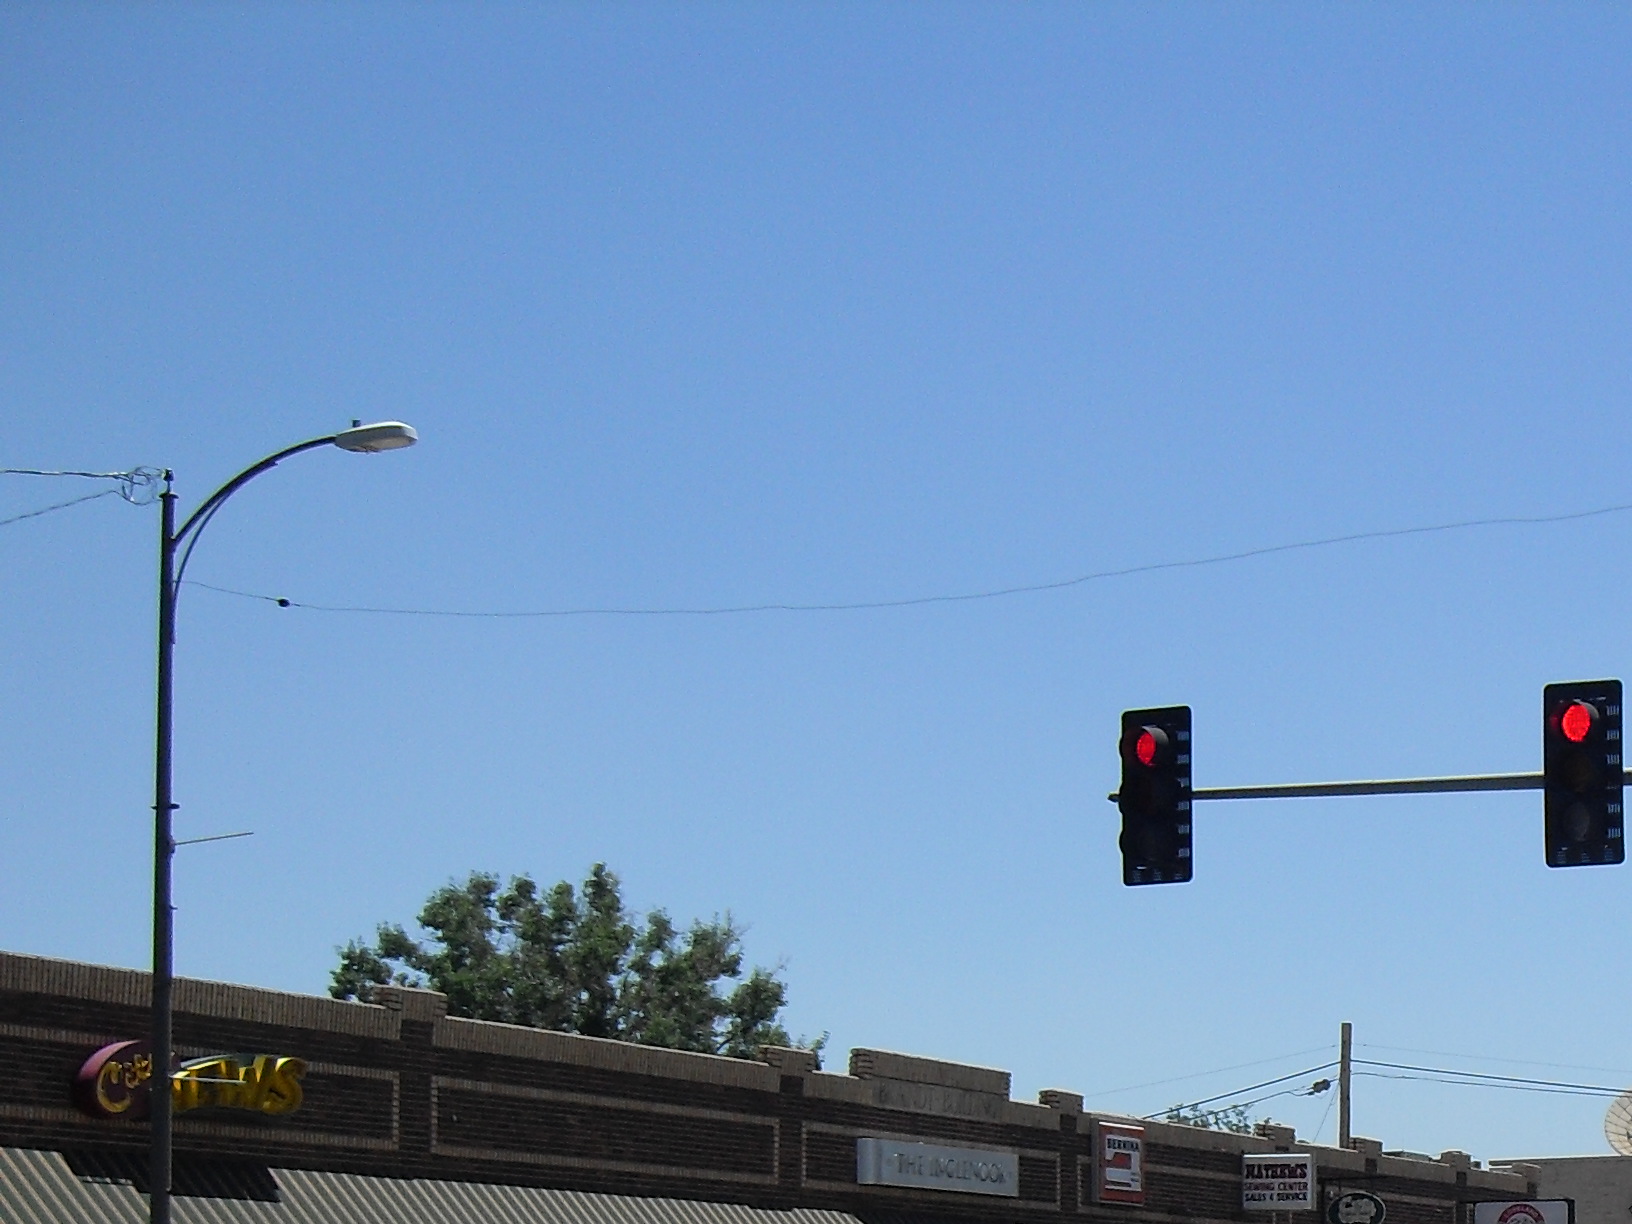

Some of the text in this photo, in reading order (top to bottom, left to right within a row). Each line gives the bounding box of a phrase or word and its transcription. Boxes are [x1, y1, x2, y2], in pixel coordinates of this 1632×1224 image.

[896, 1152, 1007, 1184] THE INGLENOOK
[1277, 1181, 1308, 1191] CENTER
